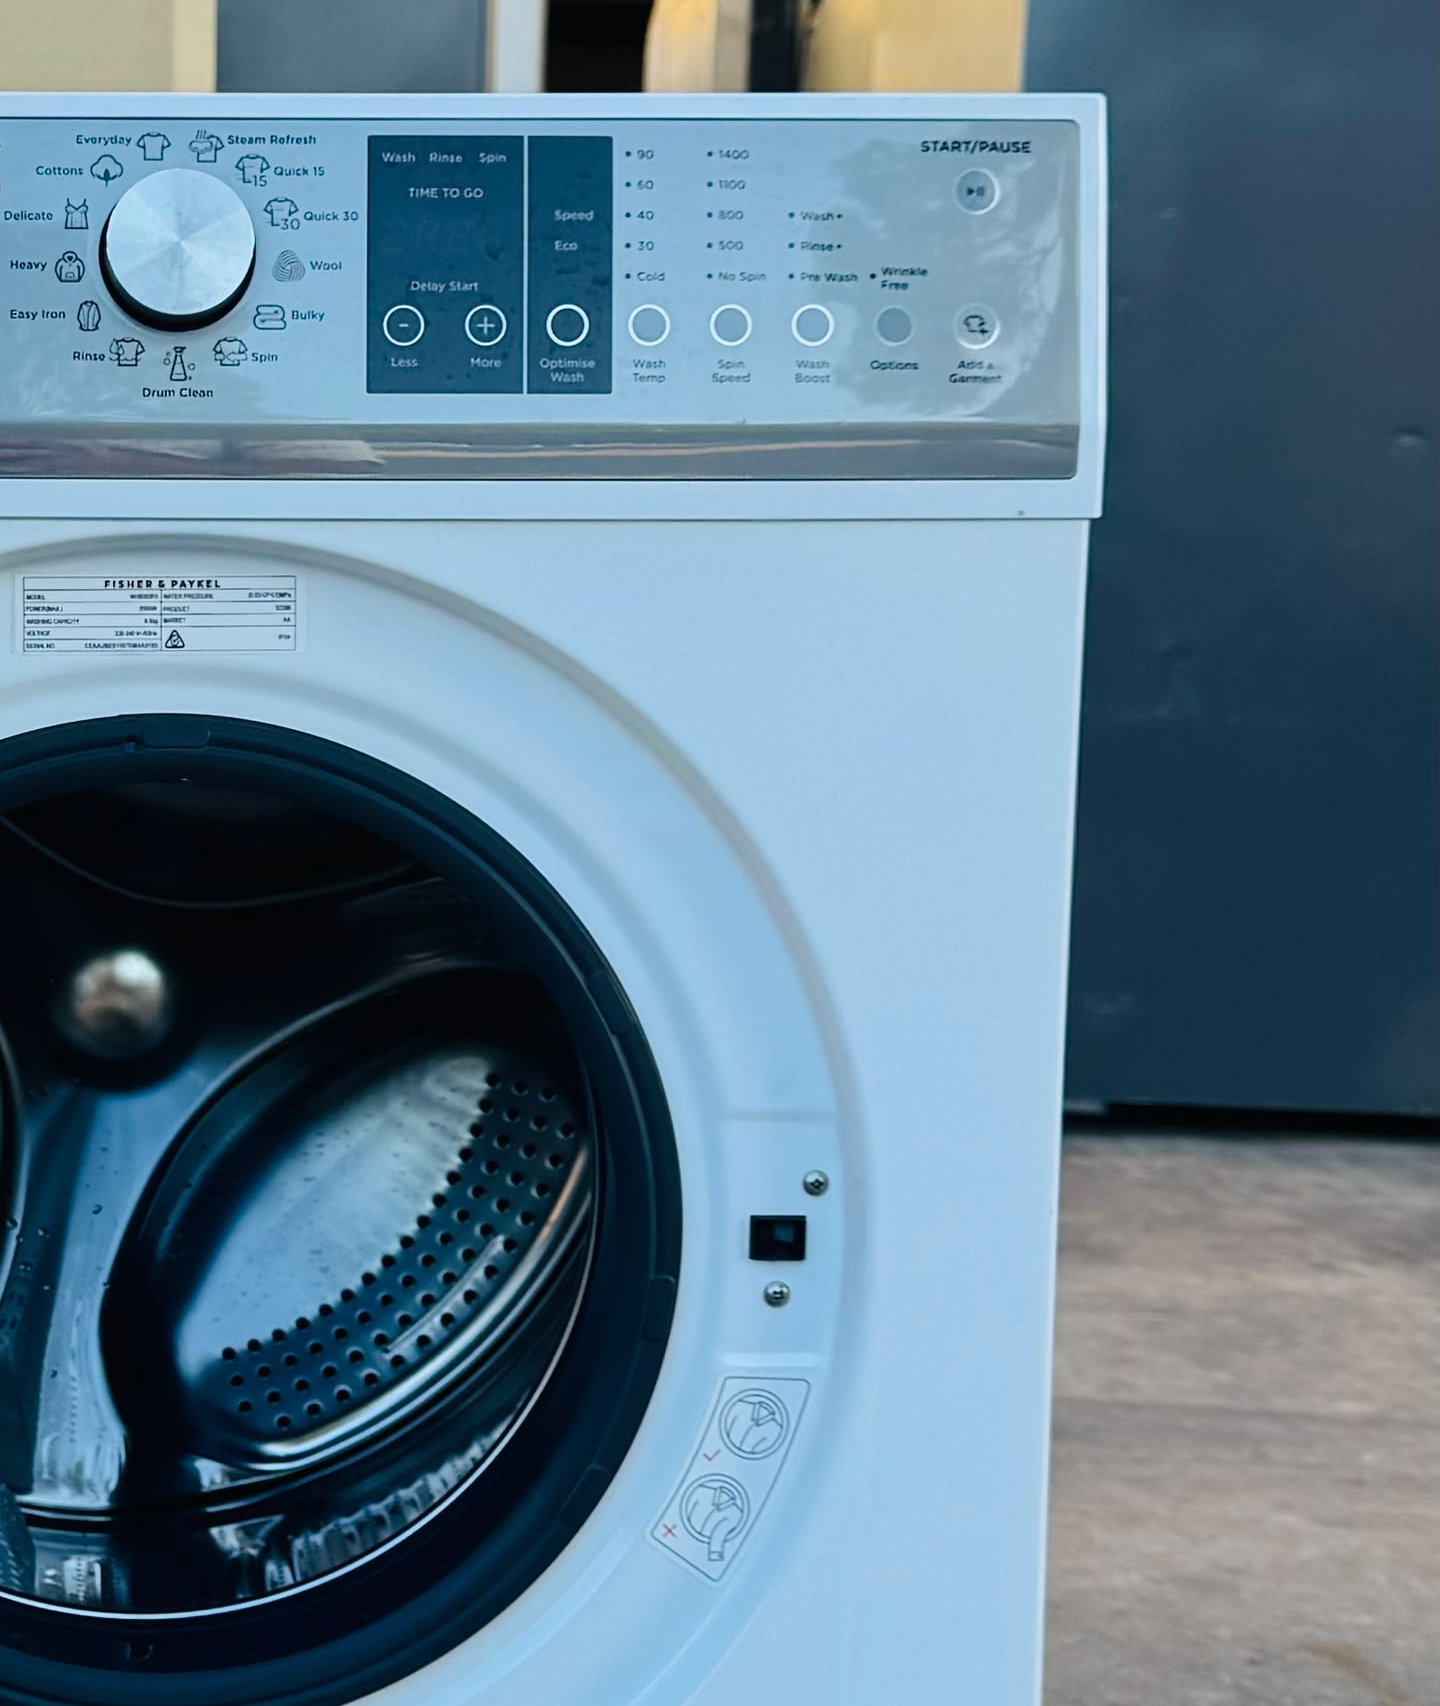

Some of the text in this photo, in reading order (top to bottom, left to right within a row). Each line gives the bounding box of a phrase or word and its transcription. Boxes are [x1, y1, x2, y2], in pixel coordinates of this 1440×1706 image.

[76, 135, 132, 147] Everyday
[227, 134, 316, 145] Steam Refresh
[920, 140, 1031, 154] START/PAUSE
[382, 152, 416, 163] Wash
[429, 152, 462, 163] Rinse
[479, 152, 506, 164] Spin
[637, 150, 654, 159] 90
[718, 149, 749, 160] 1400
[36, 165, 84, 176] Cottons
[274, 165, 325, 177] Quick 15
[252, 174, 268, 187] 15
[718, 180, 745, 190] 1100
[408, 188, 484, 198] TIME TO GO
[4, 211, 53, 221] Delicate
[304, 211, 359, 222] Quick 30
[554, 210, 594, 221] Speed
[637, 211, 654, 220] 40
[280, 218, 300, 231] 30
[554, 241, 578, 251] Eco
[637, 241, 654, 251] 30
[10, 260, 47, 273] Heavy
[310, 260, 342, 271] Wool
[637, 271, 665, 281] Cold
[718, 271, 767, 283] No Spin
[800, 272, 858, 282] Pre Wash
[881, 267, 928, 277] Wrinkle
[410, 281, 479, 293] Delay Start
[881, 280, 909, 291] Free
[9, 309, 66, 322] Easy Iron
[291, 309, 325, 322] Bulky
[73, 351, 105, 362] Rinse
[252, 351, 278, 364] Spin
[391, 357, 418, 368] Less
[470, 358, 502, 368] More
[539, 358, 595, 371] Optimise
[632, 359, 666, 369] Wash
[717, 359, 745, 371] Spin
[795, 359, 829, 369] Wash
[870, 359, 919, 371] Options
[550, 372, 584, 383] Wash
[632, 373, 665, 384] Temp
[711, 373, 751, 385] Speed
[795, 372, 830, 384] Boost
[142, 388, 214, 398] Drum Clean
[104, 580, 152, 588] FISHER
[171, 580, 220, 588] PAYKEL
